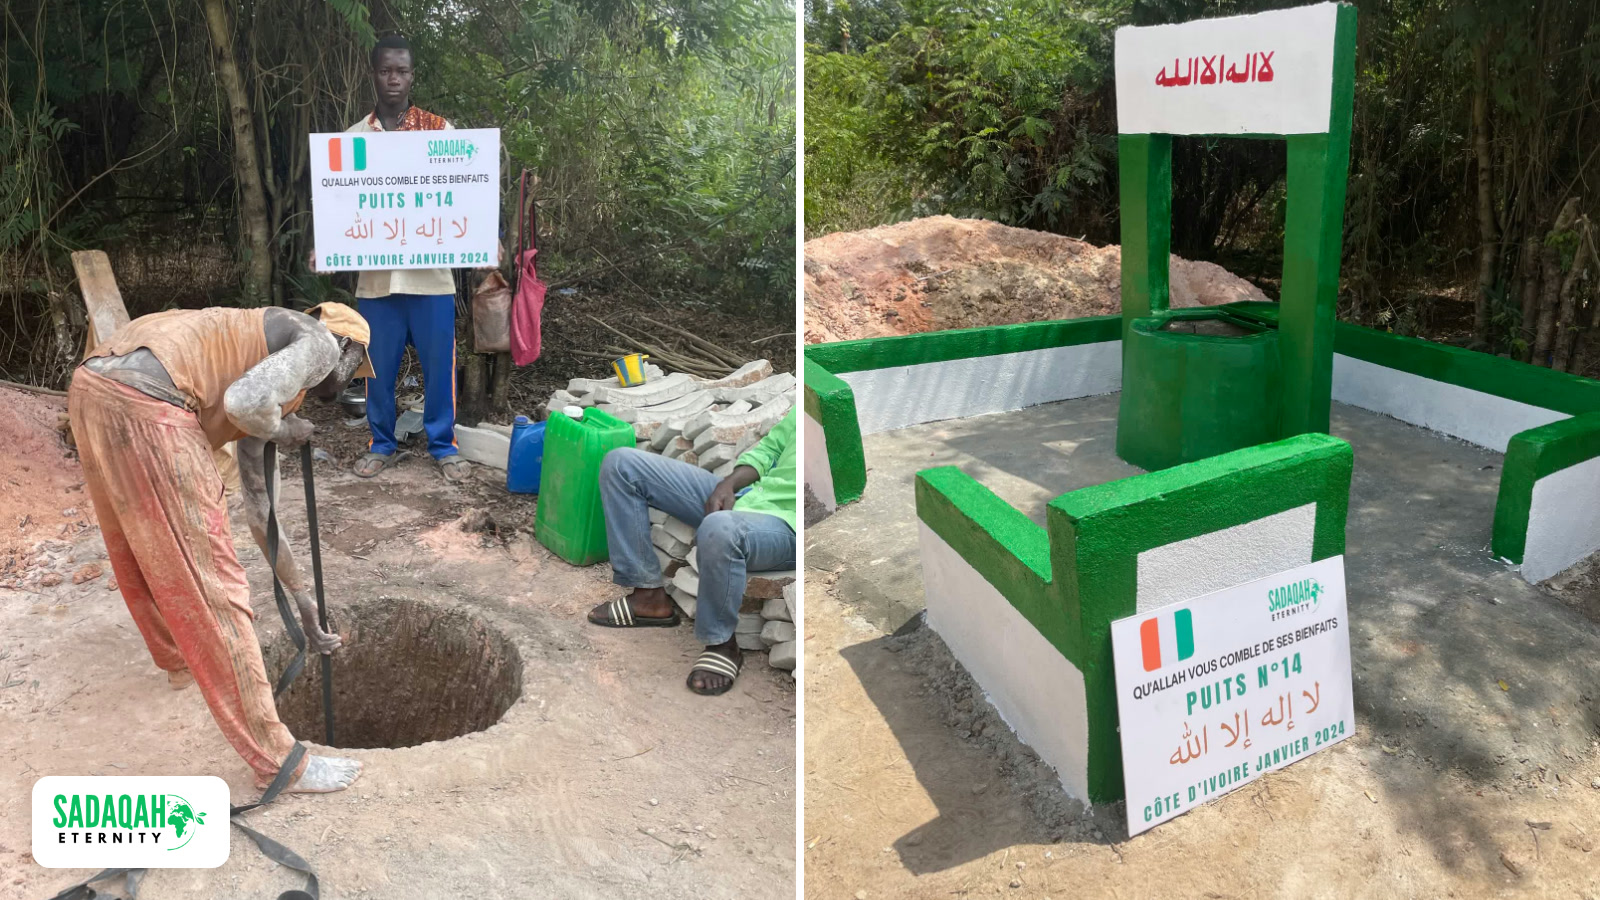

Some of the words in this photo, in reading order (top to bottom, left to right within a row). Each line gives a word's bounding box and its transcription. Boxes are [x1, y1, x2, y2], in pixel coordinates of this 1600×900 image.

[428, 140, 465, 156] SADAQAH
[322, 178, 359, 187] QU'ALLAH
[361, 177, 383, 185] VOUS
[385, 176, 418, 185] COMBLE
[420, 176, 430, 184] DE
[432, 175, 447, 184] SES
[449, 174, 489, 183] BIENFAITS
[359, 193, 405, 209] PUITS
[415, 191, 453, 207] N°14
[326, 254, 351, 266] CÔTE
[358, 254, 403, 266] D'IVOIRE
[410, 253, 454, 265] JANVIER
[461, 252, 488, 263] 2024
[1268, 579, 1311, 612] SADAQAH
[1272, 603, 1310, 621] ETERNITY
[1134, 671, 1186, 700] QU'ALLAH
[1188, 660, 1217, 678] VOUS
[1220, 645, 1260, 669] COMBLE
[1263, 639, 1274, 653] DE
[1277, 633, 1294, 649] SES
[1296, 617, 1338, 642] BIENFAITS
[1187, 673, 1246, 715] PUITS
[1258, 652, 1302, 688] N°14
[1144, 792, 1180, 822] CÔTE
[1188, 762, 1249, 803] D'IVOIRE
[1256, 736, 1308, 772] JANVIER
[1315, 720, 1345, 746] 2024
